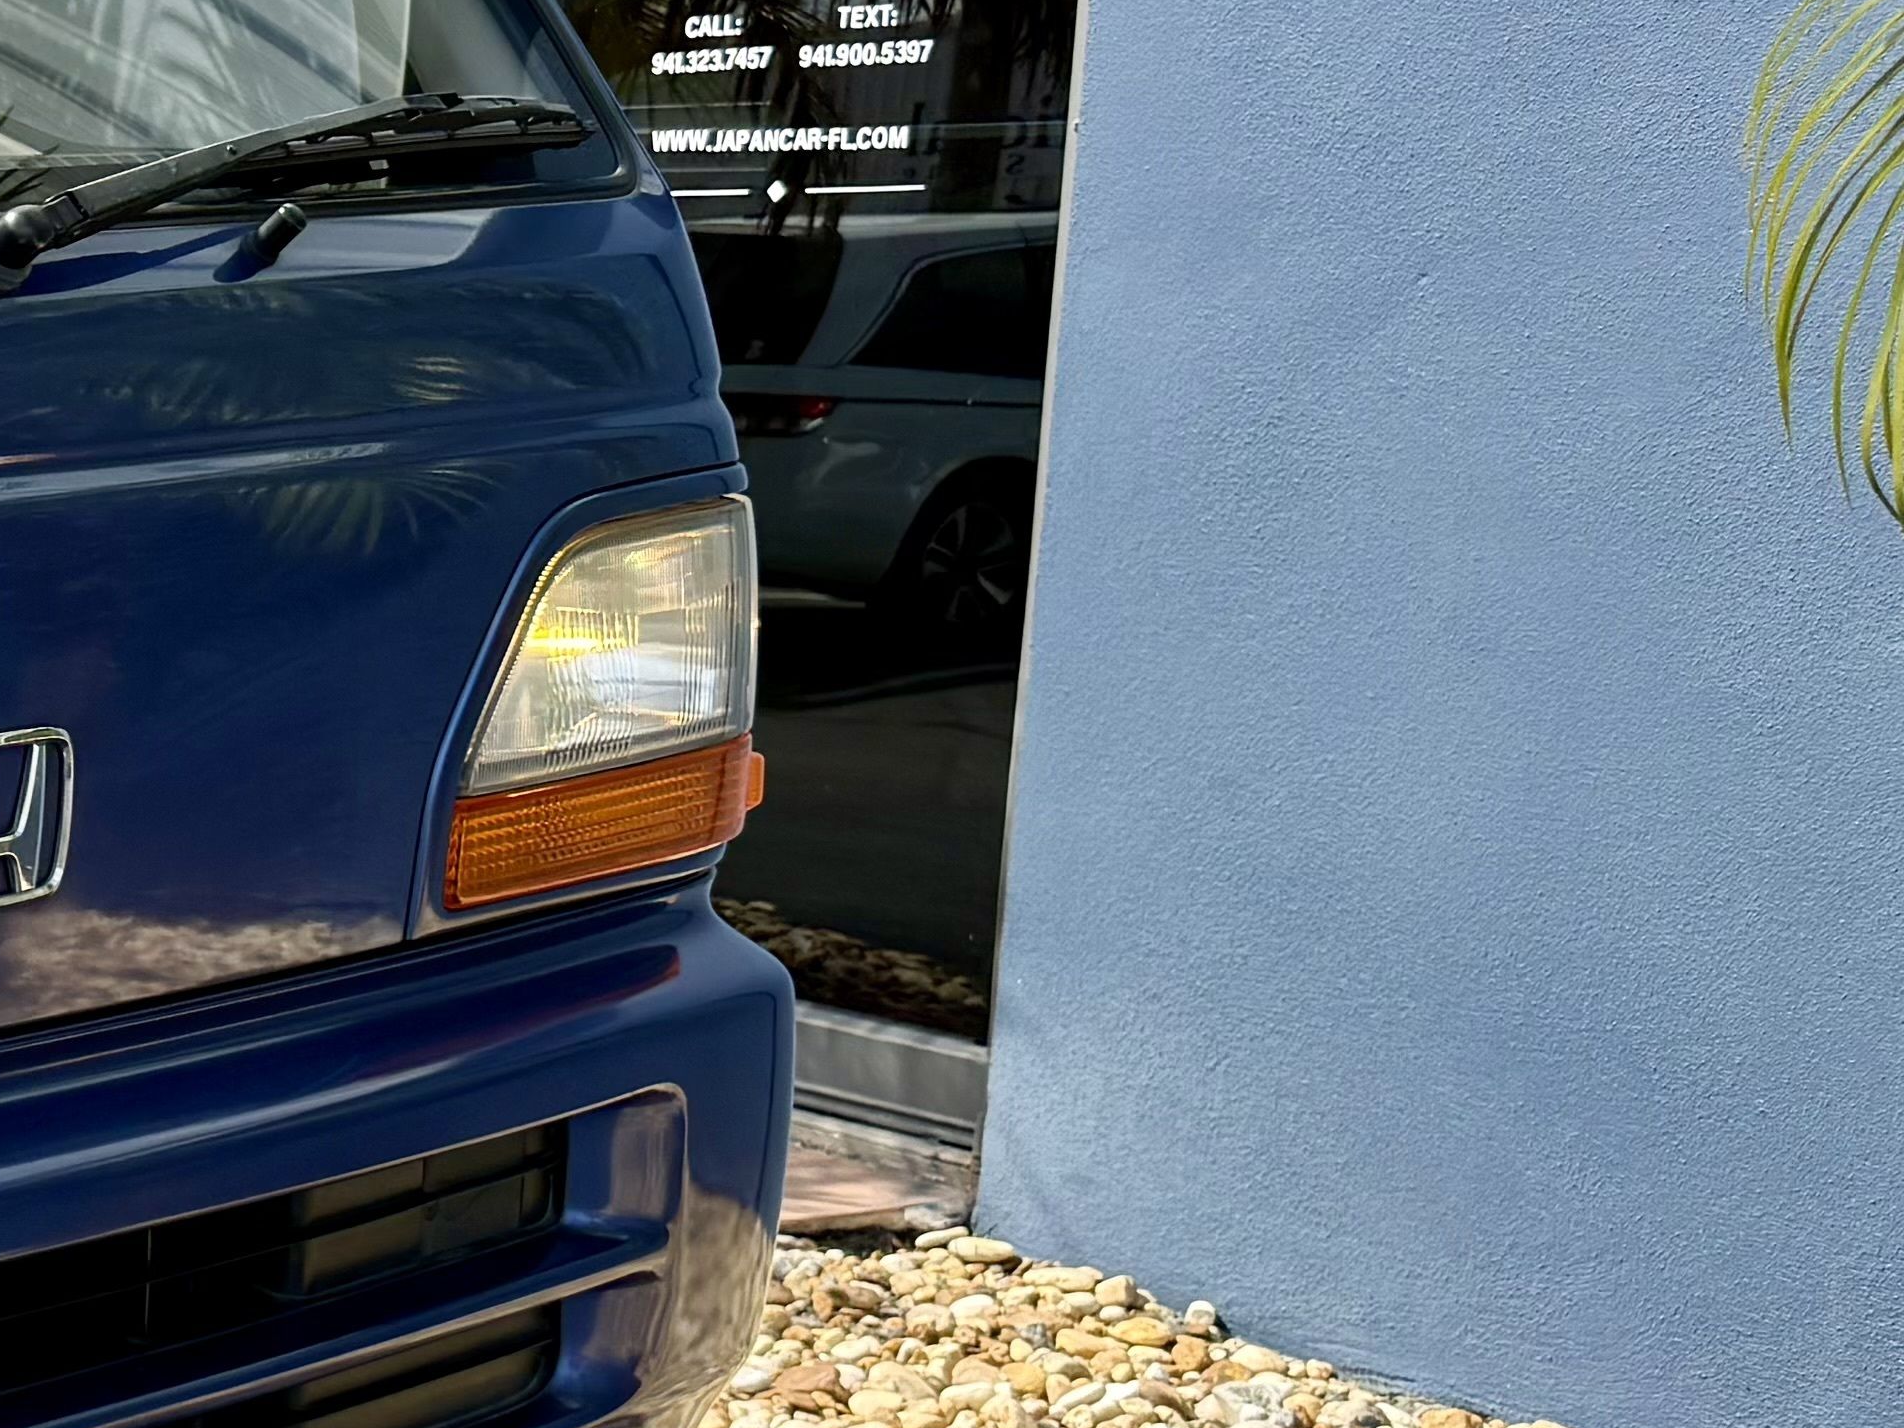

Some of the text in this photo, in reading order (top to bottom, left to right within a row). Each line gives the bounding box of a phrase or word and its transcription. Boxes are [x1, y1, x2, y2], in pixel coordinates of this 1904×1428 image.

[685, 14, 743, 39] CALL:
[837, 3, 898, 29] TEXT:
[651, 45, 775, 76] 941.323.7457
[798, 39, 935, 68] 941.900.5397
[651, 125, 910, 153] WWW.JAPANCAR-FL.COM
